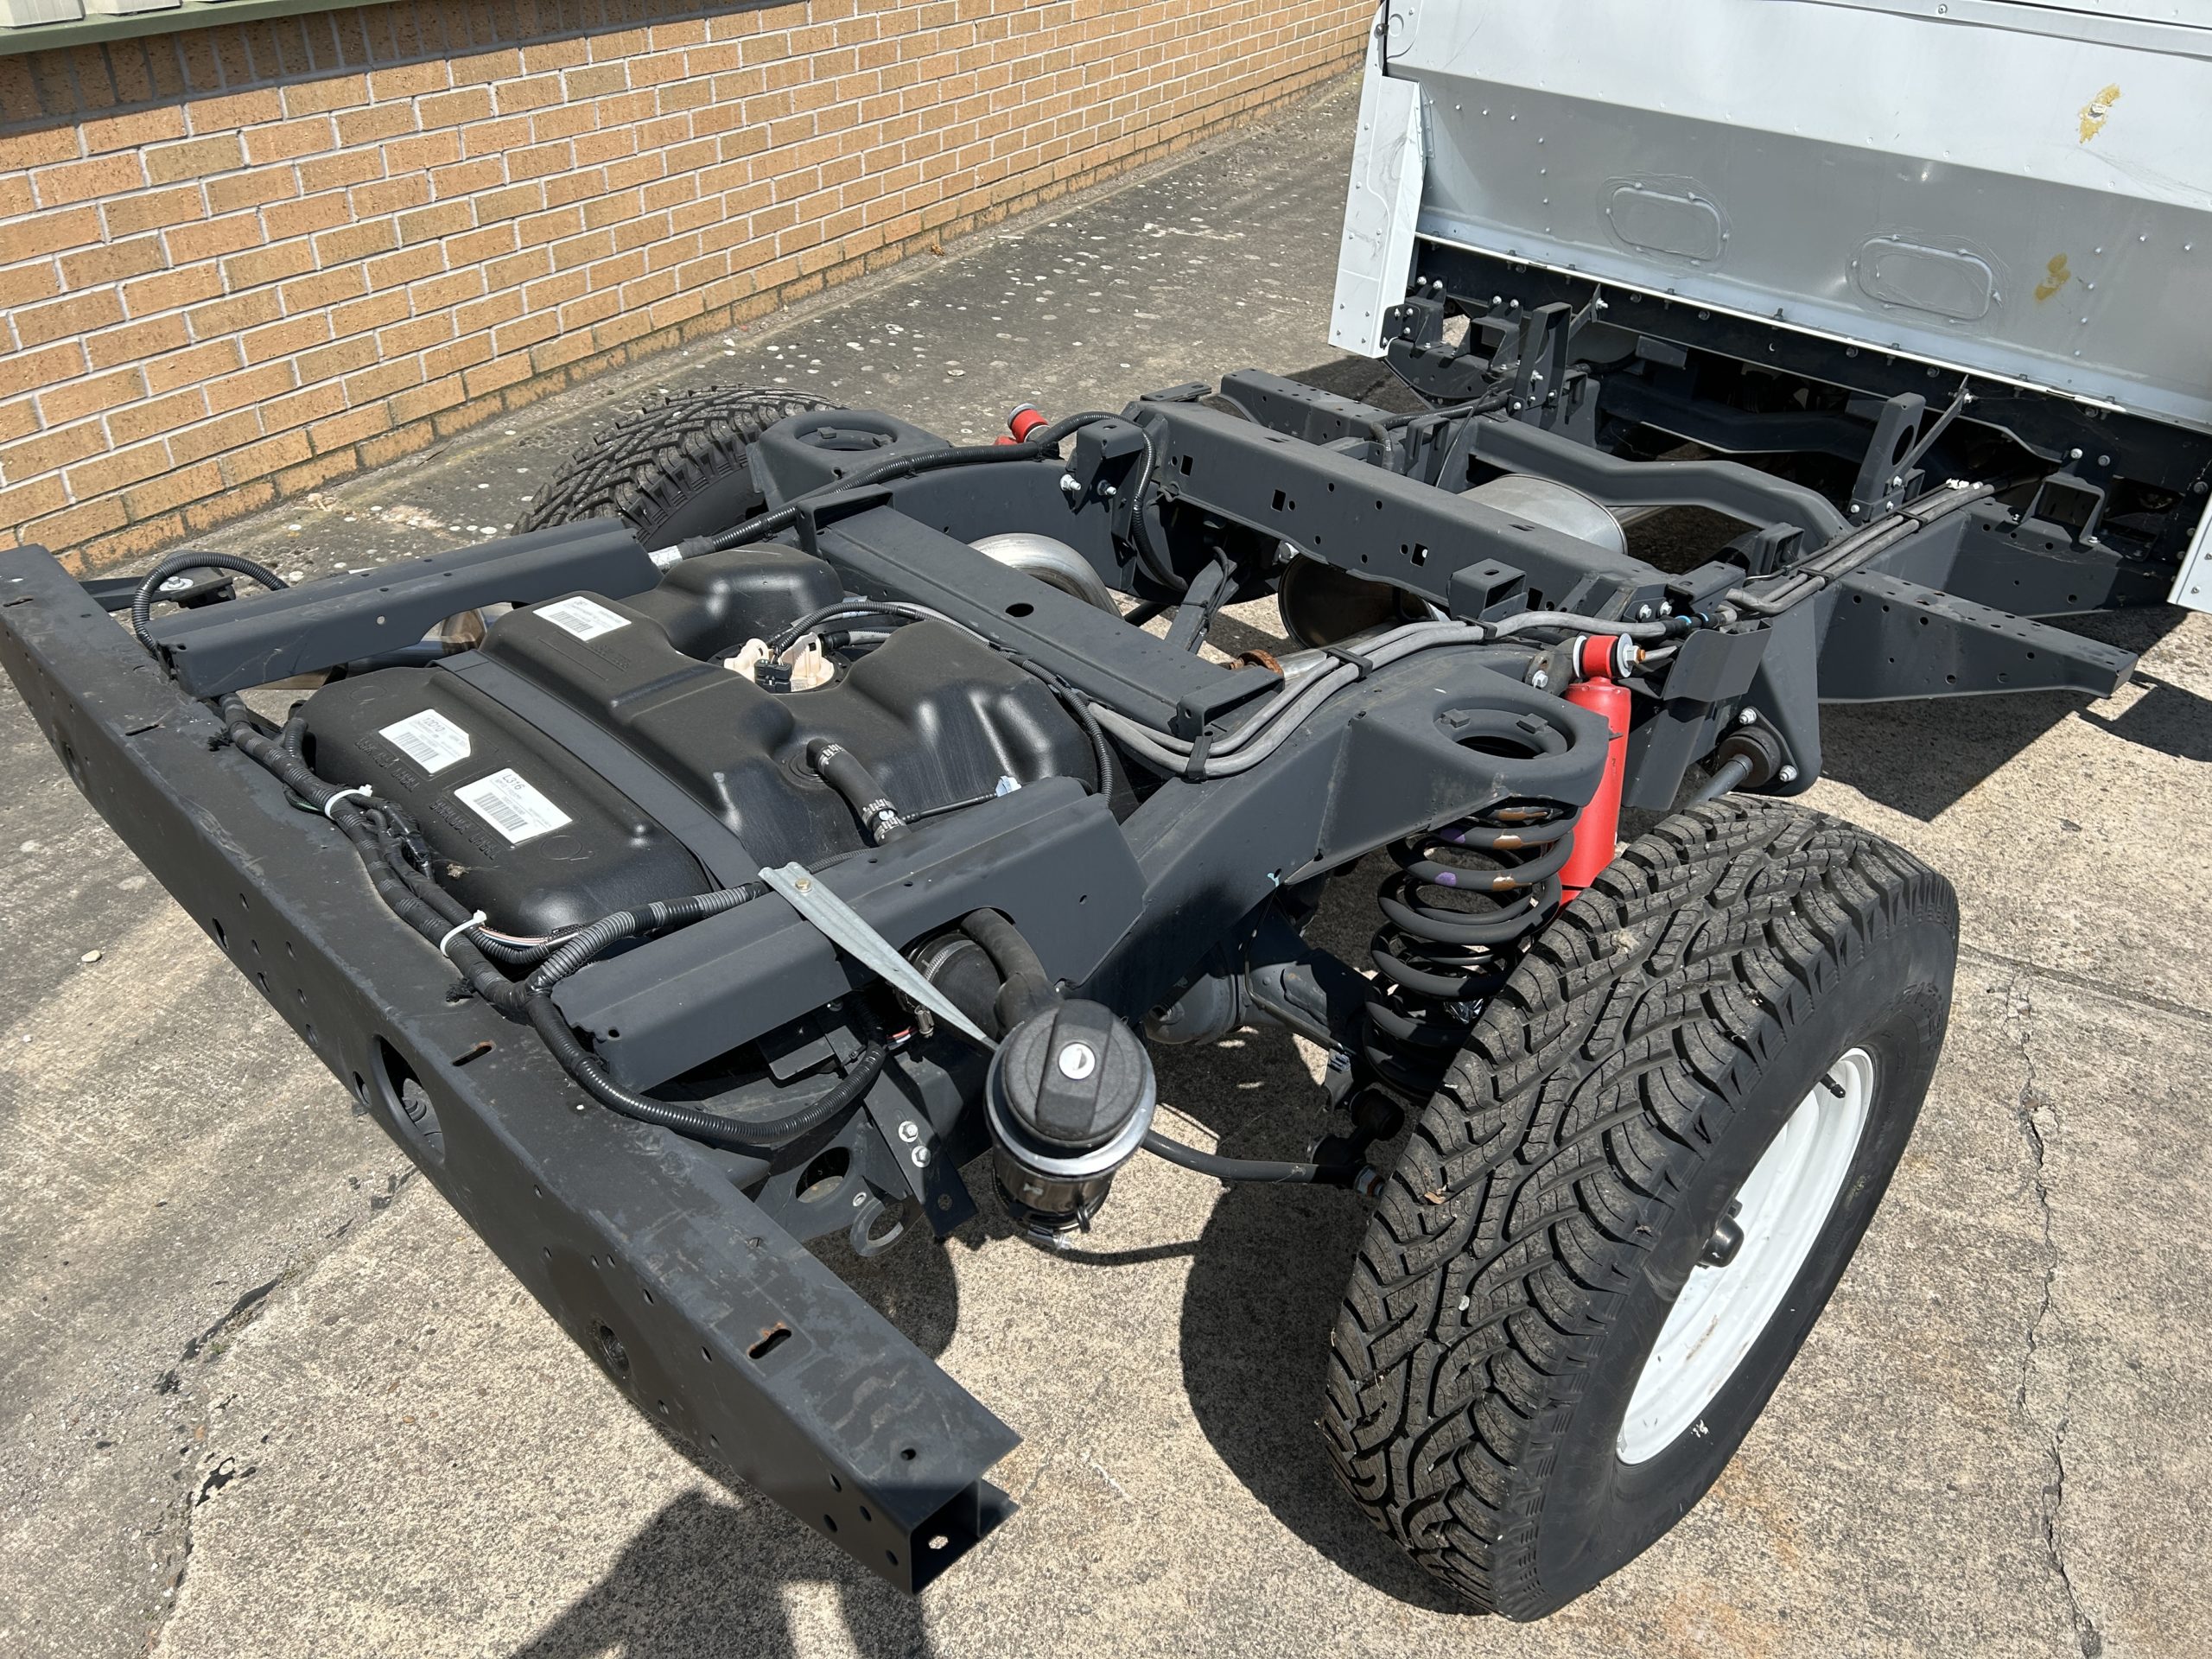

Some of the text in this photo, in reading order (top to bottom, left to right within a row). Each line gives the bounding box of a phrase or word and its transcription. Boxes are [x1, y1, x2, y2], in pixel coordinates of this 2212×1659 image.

[391, 768, 420, 792] LABEL
[502, 773, 525, 791] L316
[429, 798, 471, 835] BARCODE
[469, 830, 498, 861] LABEL
